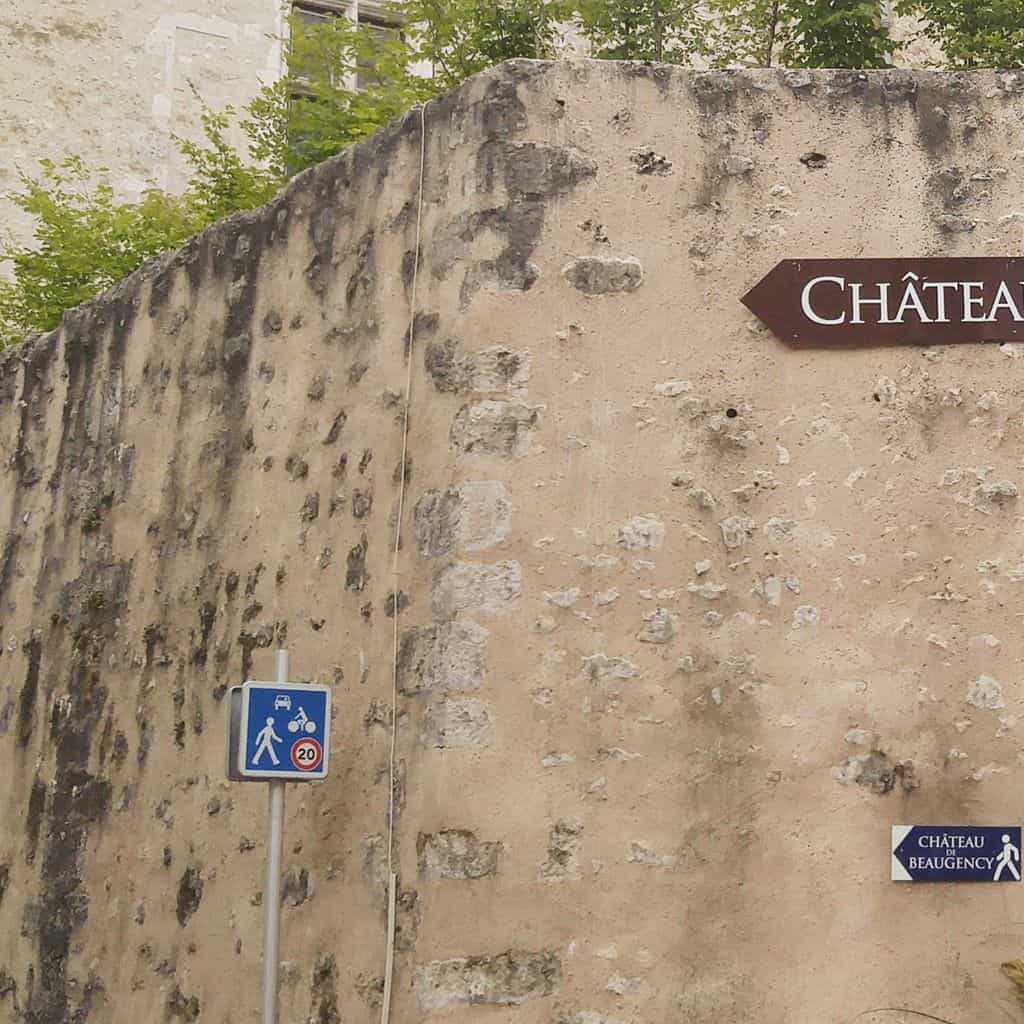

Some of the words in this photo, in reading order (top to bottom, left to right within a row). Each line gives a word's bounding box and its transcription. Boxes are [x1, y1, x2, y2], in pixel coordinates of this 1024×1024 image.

[298, 748, 316, 760] 20
[918, 833, 985, 848] CHÂTEAU
[909, 856, 994, 869] BEAUGENCY
